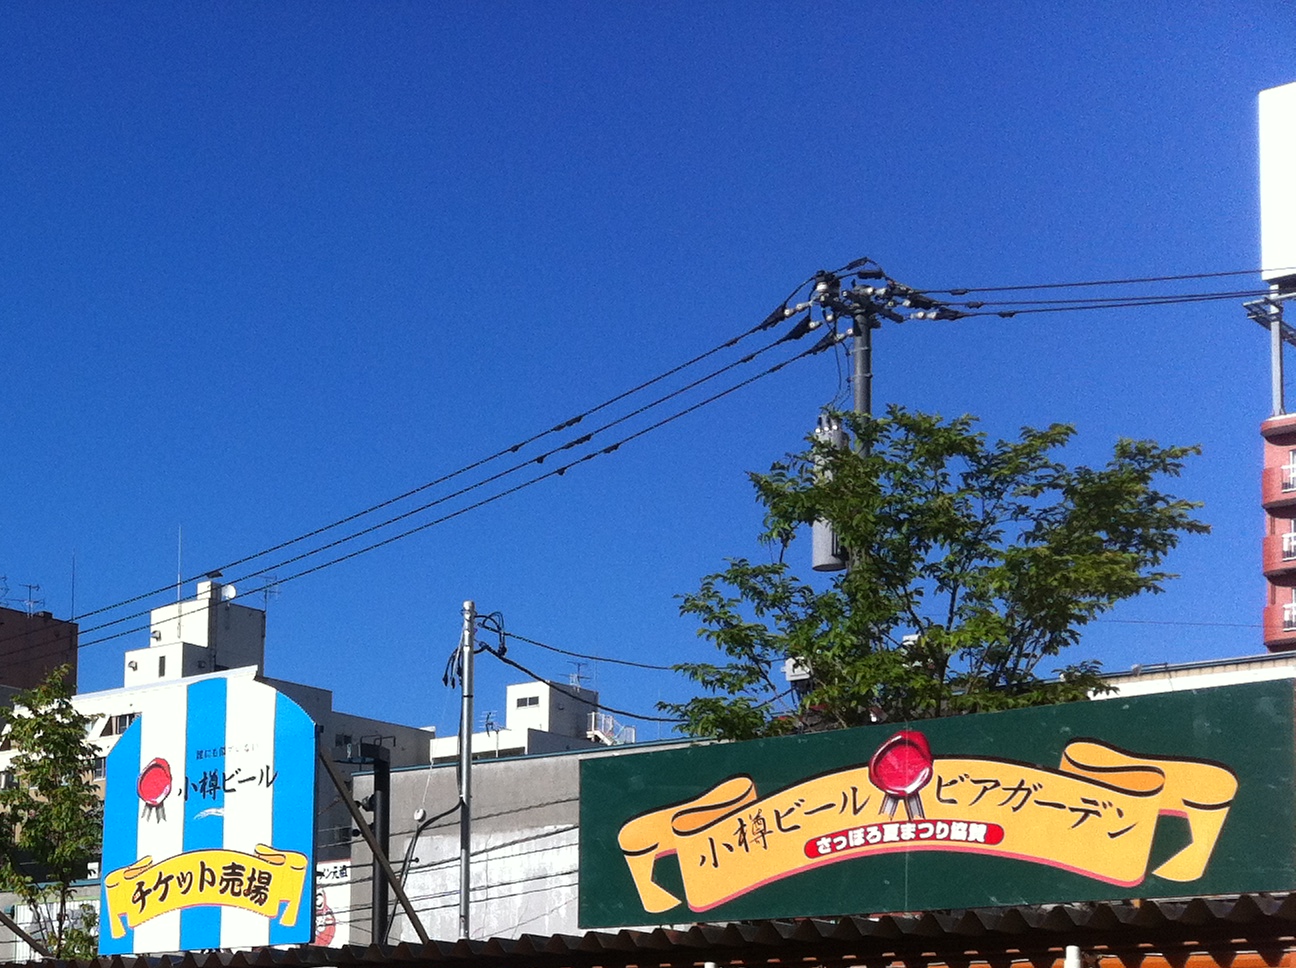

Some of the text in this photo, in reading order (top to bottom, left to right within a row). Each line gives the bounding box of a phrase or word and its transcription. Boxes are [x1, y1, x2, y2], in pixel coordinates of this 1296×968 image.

[178, 764, 279, 801] 小樽ビール
[699, 773, 1138, 869] 小樽ビール ビアガーデン
[816, 821, 988, 855] さっぽろ夏まつり協賛
[130, 860, 273, 914] チケット売場
